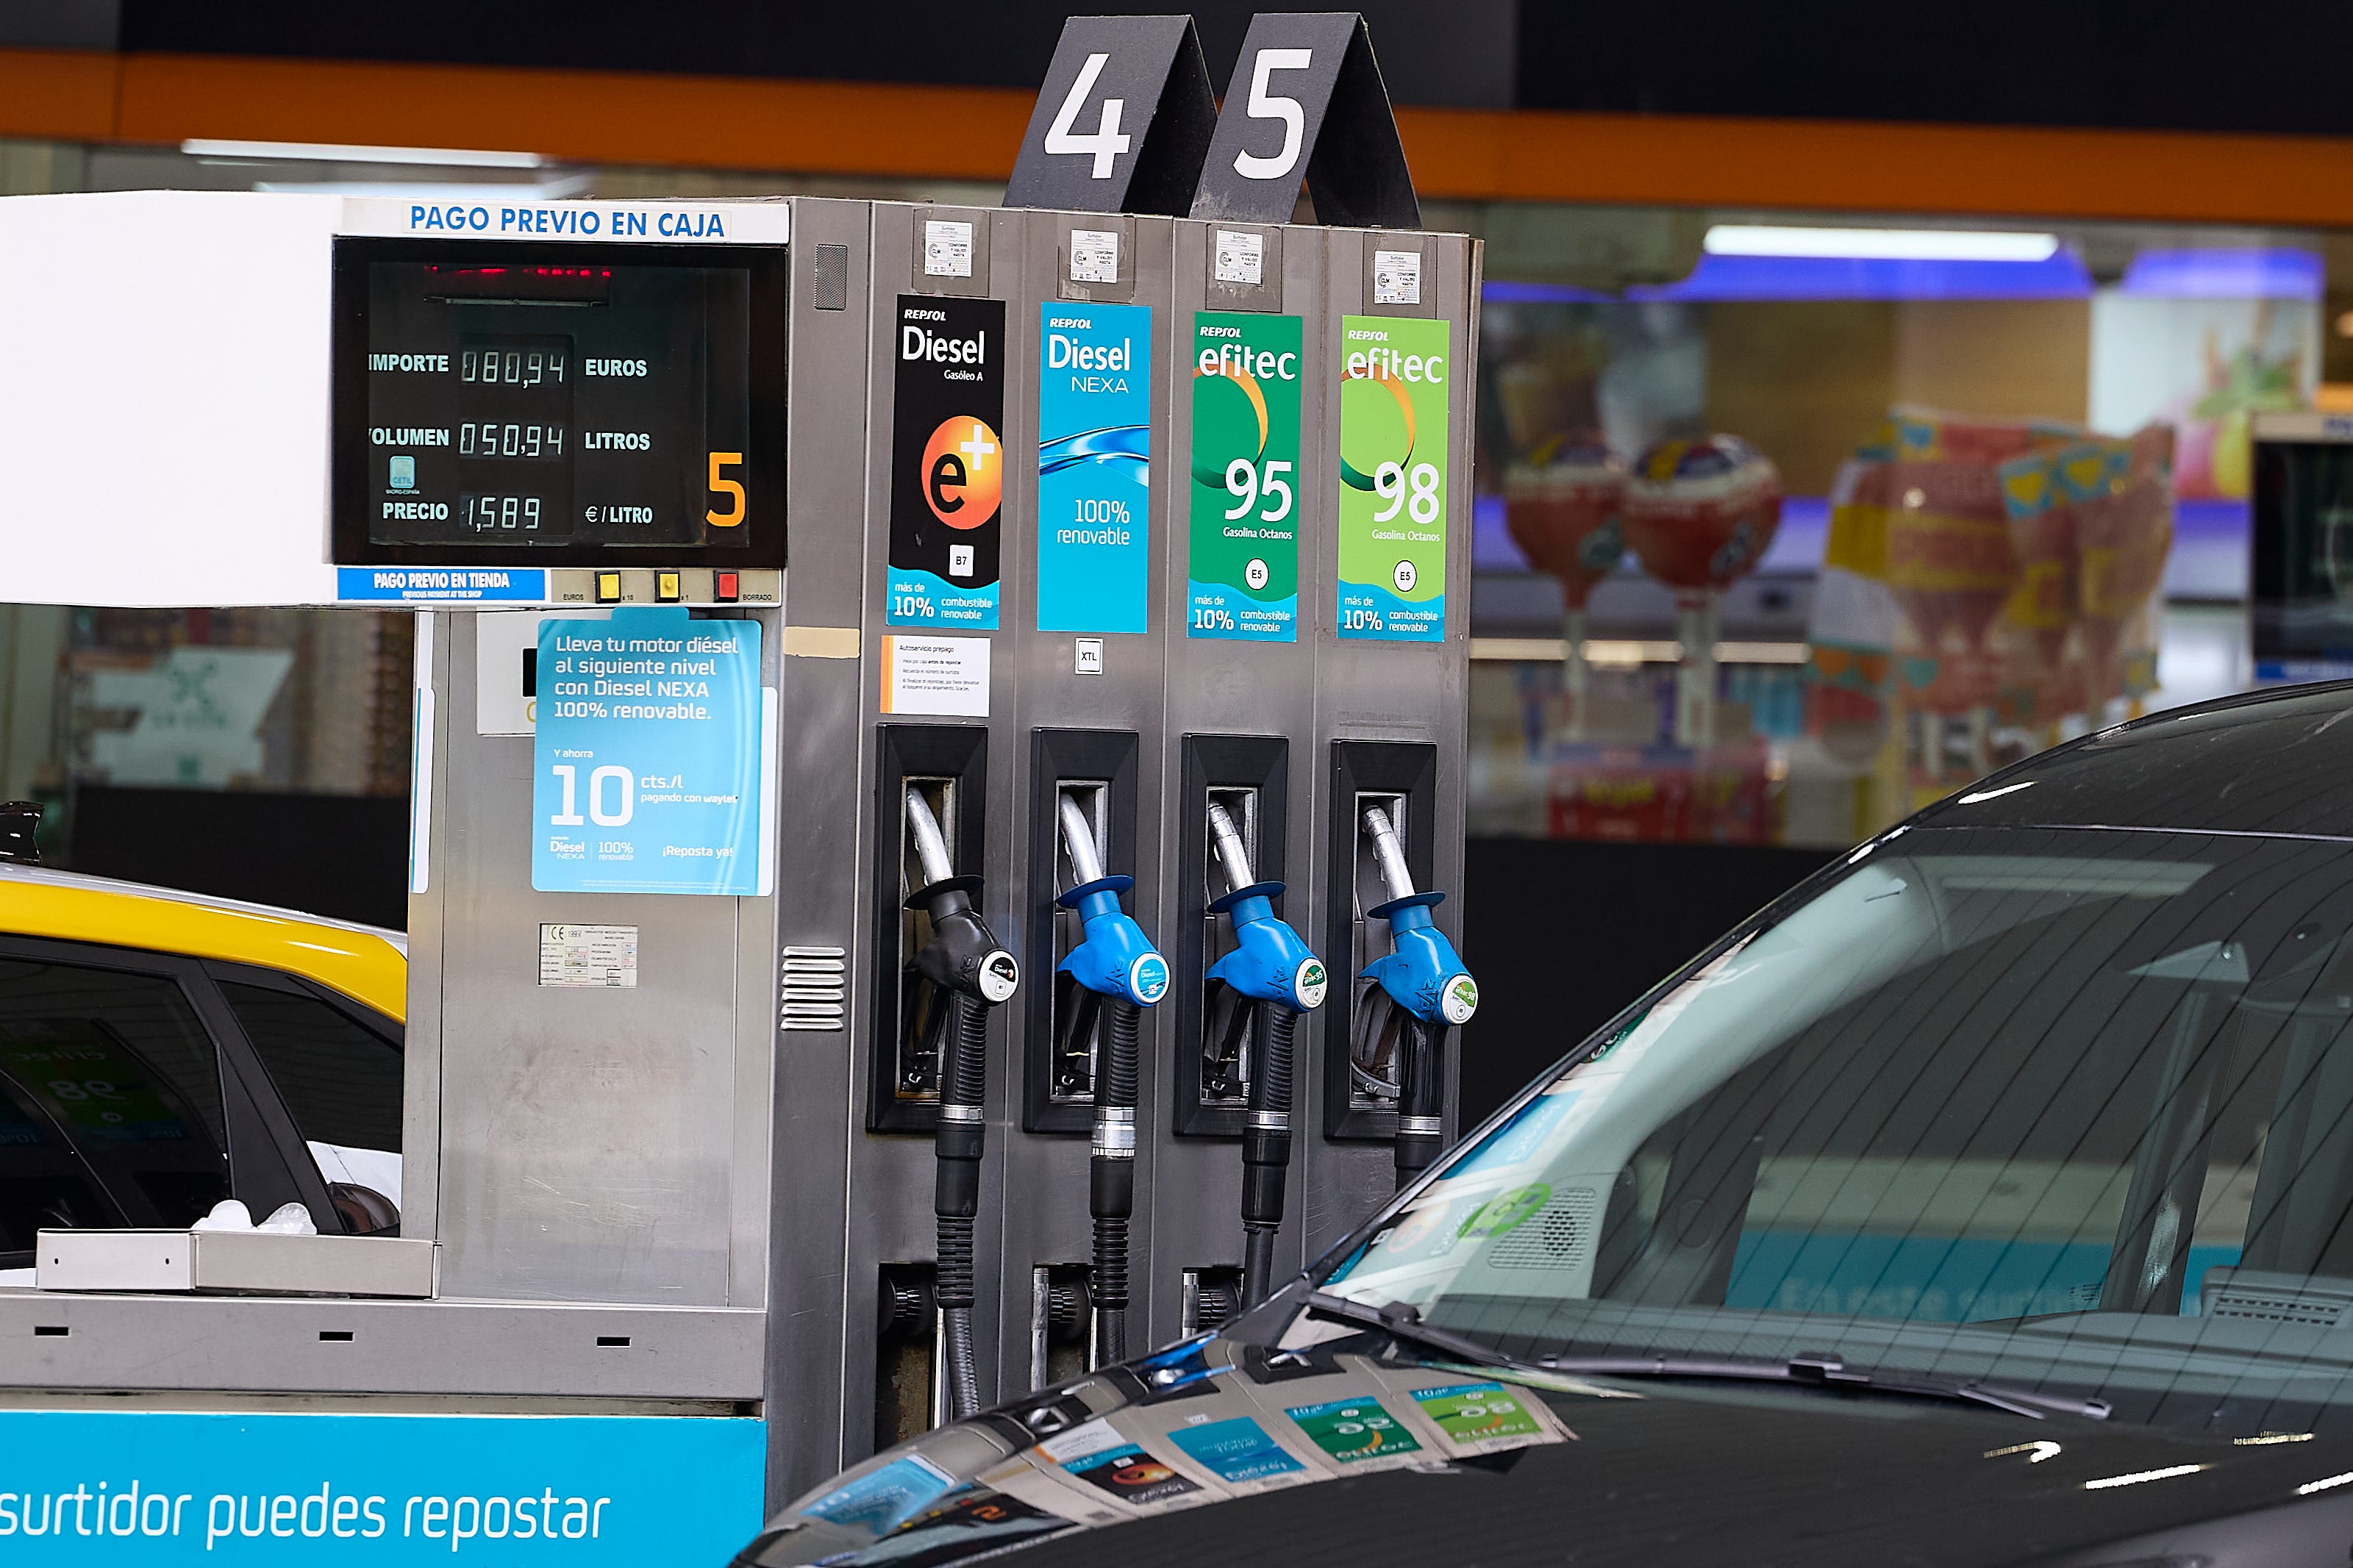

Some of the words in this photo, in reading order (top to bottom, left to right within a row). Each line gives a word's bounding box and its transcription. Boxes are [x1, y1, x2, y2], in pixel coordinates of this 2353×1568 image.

[1044, 53, 1131, 179] 4
[1232, 49, 1313, 179] 5
[410, 206, 489, 231] PAGO
[501, 208, 600, 235] PREVIO
[612, 212, 647, 236] EN
[658, 212, 725, 237] CAJA
[904, 309, 946, 321] REPSOL
[1049, 318, 1092, 329] REPSOL
[1200, 326, 1241, 338] REPSOL
[1348, 329, 1388, 341] REPSOL
[902, 326, 985, 364] Diesel
[1049, 334, 1130, 371] Diesel
[368, 354, 449, 372] IMPORTE
[585, 359, 647, 377] EUROS
[1199, 343, 1296, 381] efitec
[1347, 347, 1443, 384] efitec
[943, 369, 975, 381] Gasóleo
[976, 371, 983, 381] A
[1071, 376, 1129, 394] NEXA
[585, 433, 650, 451] LITROS
[706, 452, 746, 527] 5
[1224, 458, 1292, 522] 95
[1374, 461, 1440, 524] 98
[382, 502, 449, 520] PRECIO
[468, 497, 540, 532] 1,589
[610, 506, 653, 523] LITRO
[1074, 499, 1130, 524] 100%
[1057, 527, 1130, 545] renovable
[1223, 526, 1257, 538] Gasolina
[1259, 528, 1292, 540] Octanos
[1371, 529, 1405, 540] Gasolina
[1407, 530, 1440, 542] Octanos
[956, 556, 967, 565] B7
[374, 573, 406, 589] PAGO
[408, 573, 449, 589] PREVIO
[451, 573, 467, 588] EN
[468, 572, 510, 588] TIENDA
[1252, 570, 1262, 579] E5
[1400, 571, 1410, 581] E5
[895, 582, 913, 593] más
[914, 583, 925, 593] de
[893, 595, 935, 617] 10%
[940, 597, 993, 609] combustible
[1195, 595, 1213, 605] más
[1214, 596, 1225, 606] de
[1344, 595, 1362, 606] más
[1363, 597, 1374, 606] de
[940, 608, 982, 620] renovable
[1194, 609, 1235, 631] 10%
[1240, 609, 1290, 621] combustible
[1343, 609, 1383, 631] 10%
[1389, 610, 1438, 622] combustible
[1240, 621, 1280, 632] renovable
[1388, 622, 1429, 633] renovable
[556, 636, 603, 653] Lleva
[606, 637, 625, 653] tu
[629, 639, 683, 654] motor
[686, 636, 738, 654] diésel
[1081, 651, 1097, 662] XTL
[555, 658, 572, 673] al
[579, 658, 665, 678] siguiente
[671, 659, 716, 676] nivel
[554, 682, 588, 696] con
[594, 680, 652, 698] Diesel
[657, 681, 710, 698] NEXA
[554, 701, 607, 718] 100%
[613, 703, 712, 720] renovable.
[554, 749, 560, 757] Y
[563, 750, 593, 759] ahorra
[640, 774, 683, 789] cts./l
[551, 765, 634, 827] 10
[640, 794, 682, 804] pagando
[684, 795, 701, 803] con
[550, 841, 585, 853] Diesel
[598, 842, 634, 853] 100%
[663, 845, 713, 858] ¡Reposta
[715, 847, 733, 859] ya!
[0, 1480, 192, 1536] surtidor
[207, 1481, 385, 1550] puedes
[404, 1486, 610, 1552] repostar
